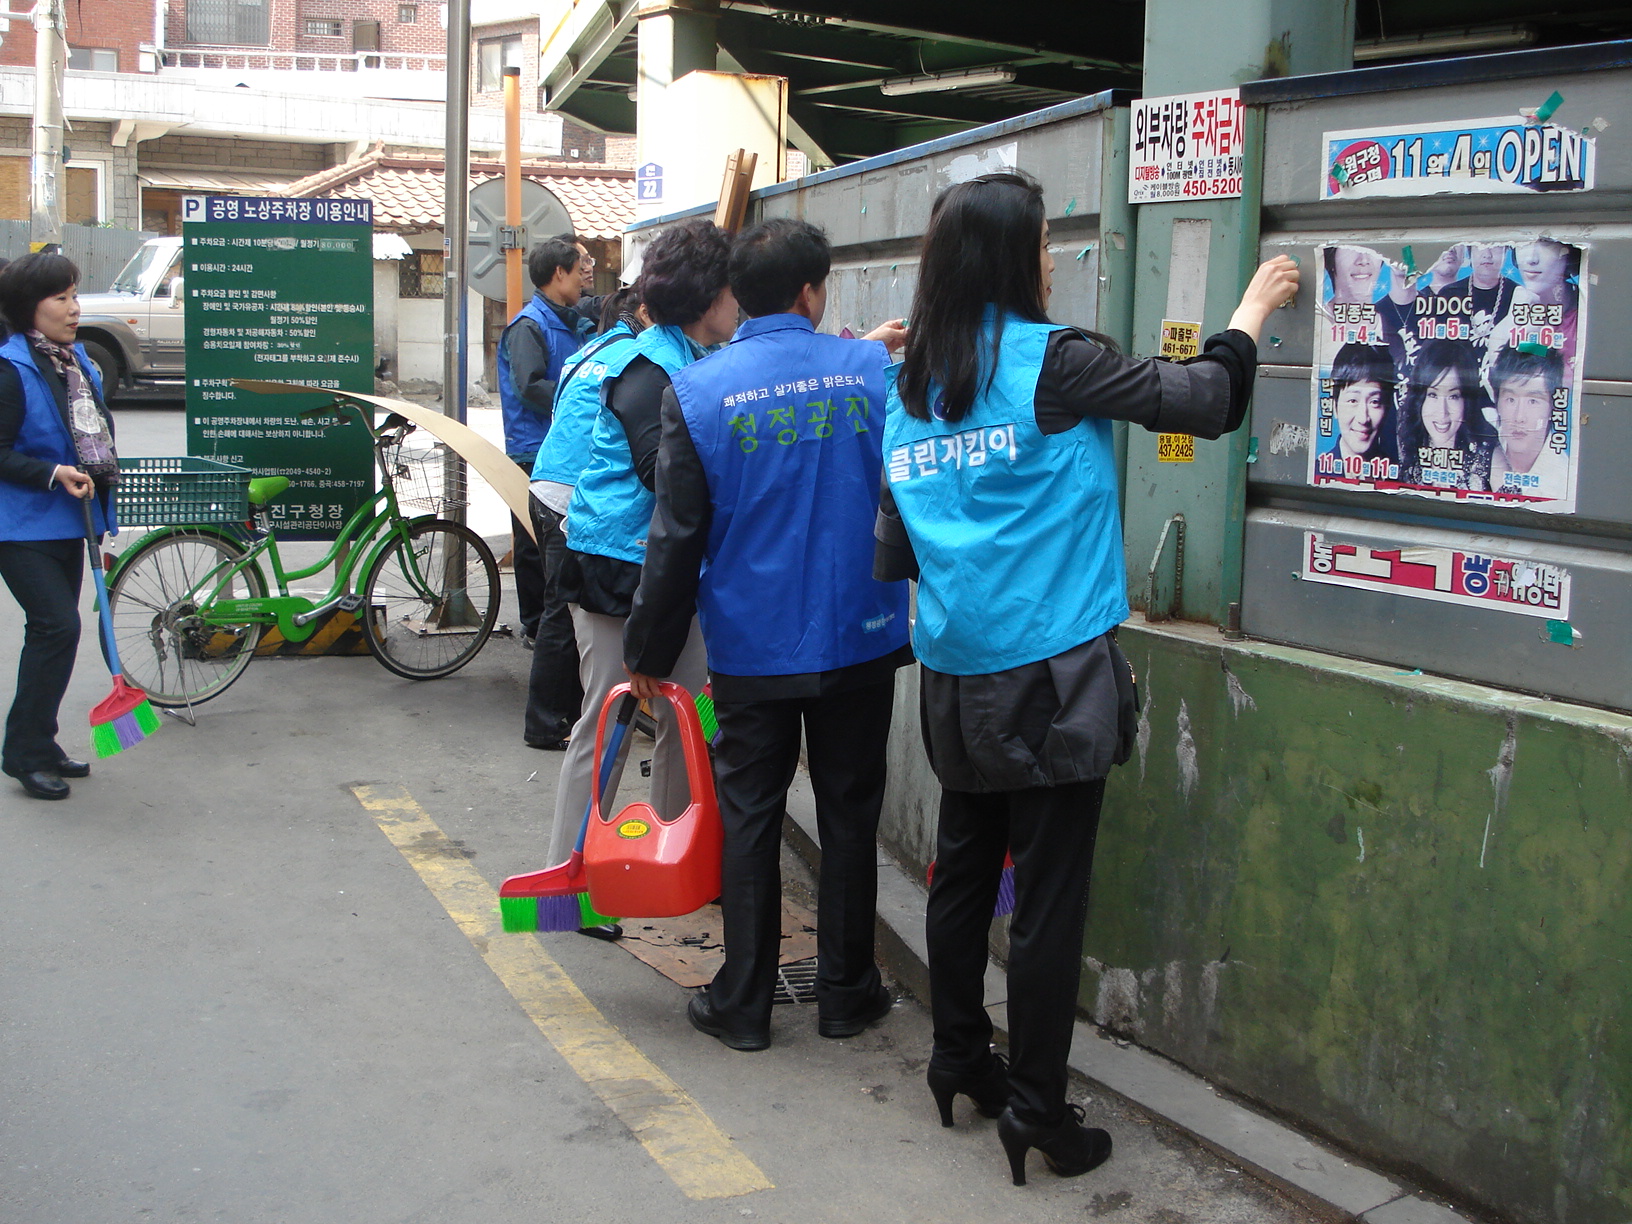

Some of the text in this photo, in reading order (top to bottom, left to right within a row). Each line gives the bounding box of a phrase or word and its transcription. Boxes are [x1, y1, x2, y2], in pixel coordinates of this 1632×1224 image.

[1135, 97, 1246, 161] 외부차량 주차금지
[1342, 143, 1381, 176] 원구청
[1496, 126, 1582, 184] OPEN
[1183, 177, 1243, 196] 450-5200
[186, 199, 370, 222] P 공영 노상주차장 이용안내
[200, 238, 226, 247] 주차요금
[231, 238, 252, 247] 시간제
[200, 263, 254, 273] 이용시간 24시간
[200, 289, 227, 298] 주차요금
[228, 290, 241, 299] 할인
[251, 290, 277, 299] 감면사항
[202, 302, 222, 311] 장애인
[232, 302, 265, 312] 국가유공자
[1332, 303, 1377, 324] 김종국
[1415, 296, 1473, 316] DJ DOC
[1512, 303, 1564, 326] 장윤정
[1170, 327, 1192, 342] 파출부
[1162, 342, 1197, 356] 461-6677
[723, 375, 865, 408] 쾌적하고 살기좋은 맑은도시
[202, 417, 210, 426] 이
[211, 417, 262, 426] 공영주차장내에서
[728, 397, 869, 453] 청정광진
[1550, 388, 1569, 454] 성진우
[265, 430, 291, 438] 보상하지
[230, 455, 244, 463] 신고
[888, 424, 1017, 483] 클린지킴이
[1159, 443, 1194, 457] 437-2425
[1418, 446, 1464, 470] 한혜진
[1421, 469, 1458, 484] 전속출연
[1504, 473, 1540, 488] 전속출연
